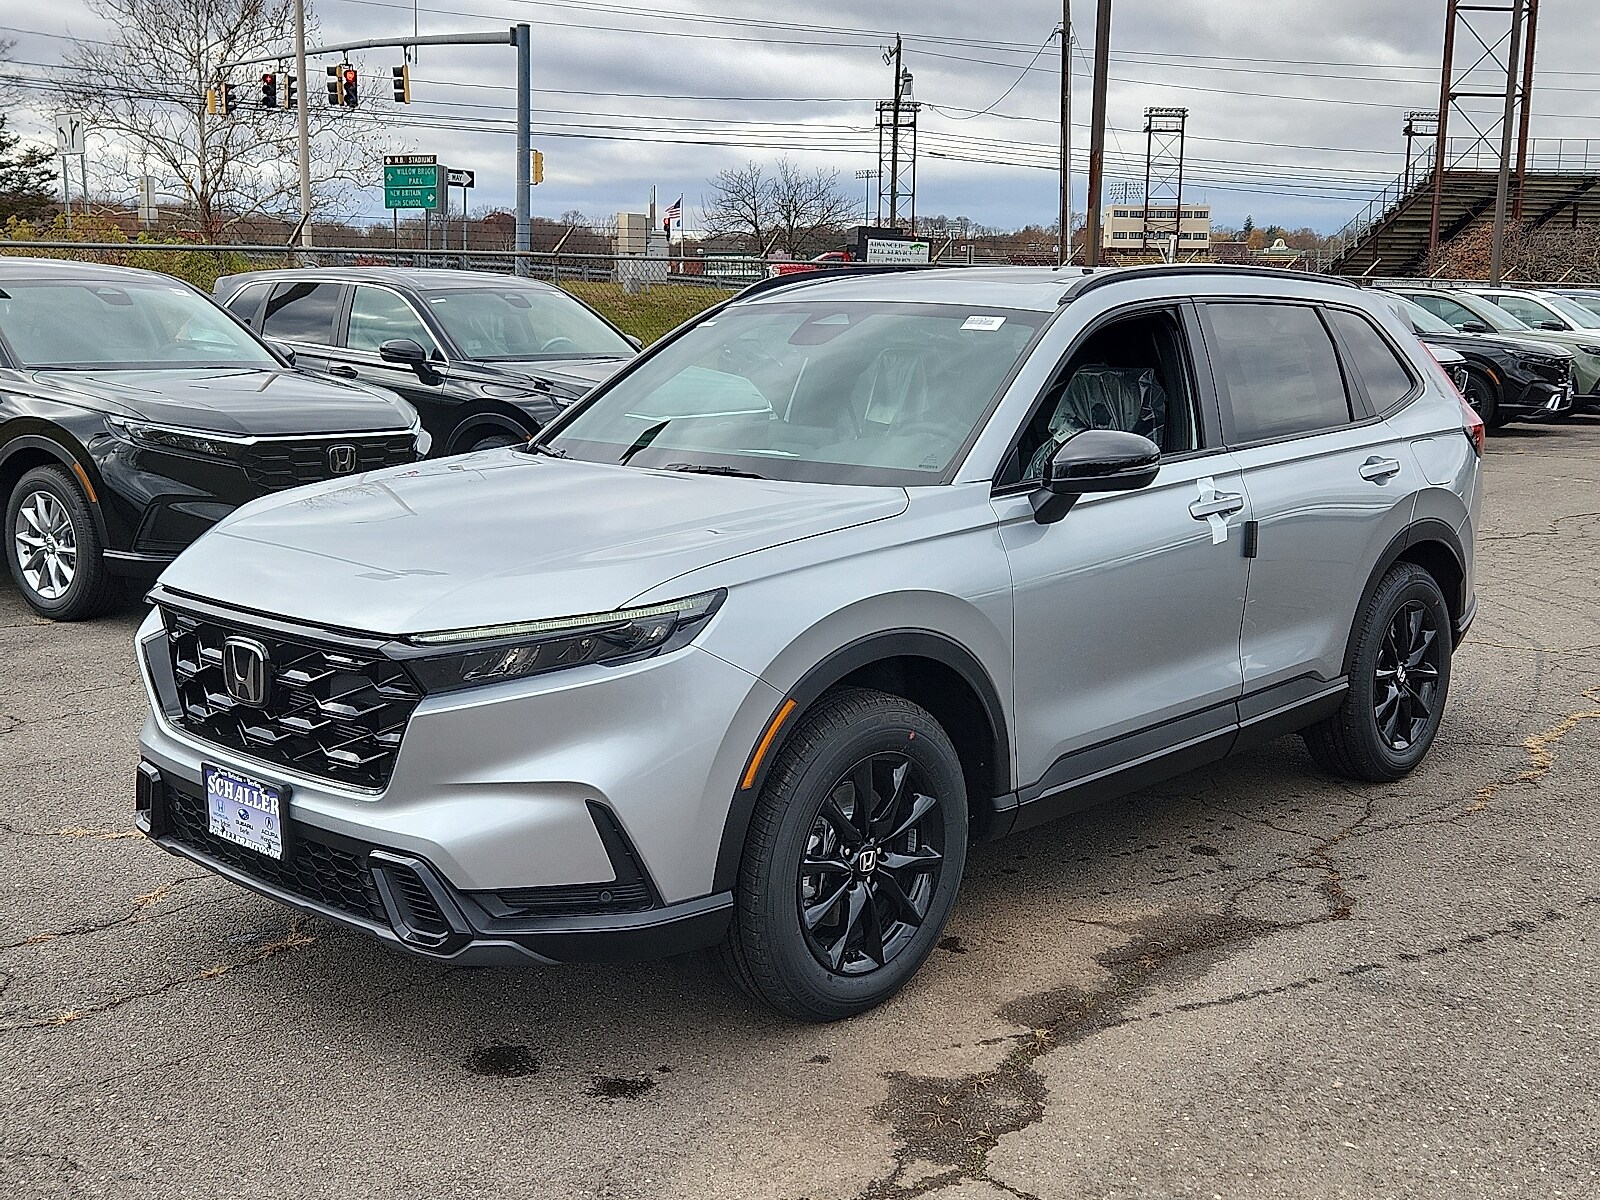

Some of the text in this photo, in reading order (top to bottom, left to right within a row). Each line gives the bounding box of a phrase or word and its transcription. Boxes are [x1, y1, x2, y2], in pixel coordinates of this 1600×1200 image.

[408, 156, 434, 164] STADIUMS
[452, 174, 463, 182] WAY
[870, 241, 904, 249] ADVANCED
[207, 774, 280, 819] SCHALLER
